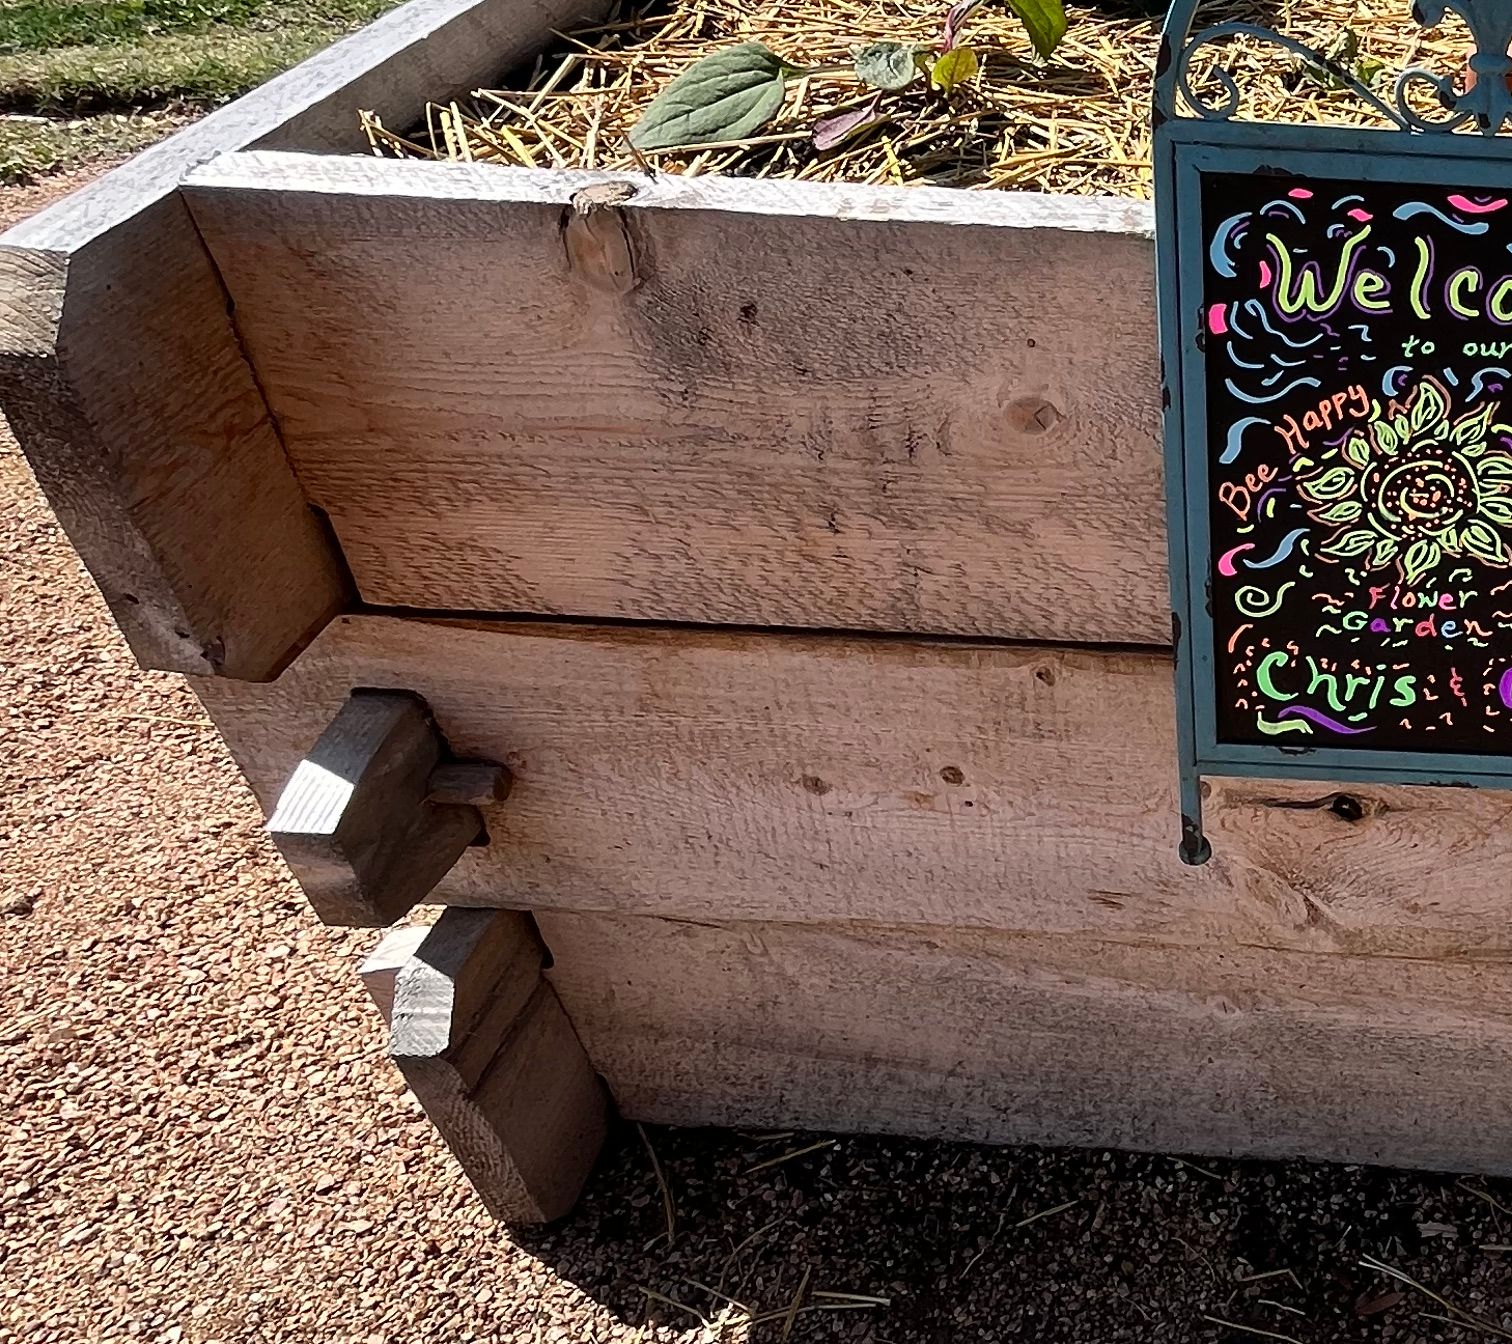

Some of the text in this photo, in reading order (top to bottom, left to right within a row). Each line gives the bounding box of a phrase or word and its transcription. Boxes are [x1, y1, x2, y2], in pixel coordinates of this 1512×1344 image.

[1401, 335, 1435, 357] to
[1219, 385, 1369, 521] Bee Happy
[1369, 583, 1477, 610] Flower
[1343, 610, 1492, 637] Garden
[1256, 651, 1417, 712] Chris
